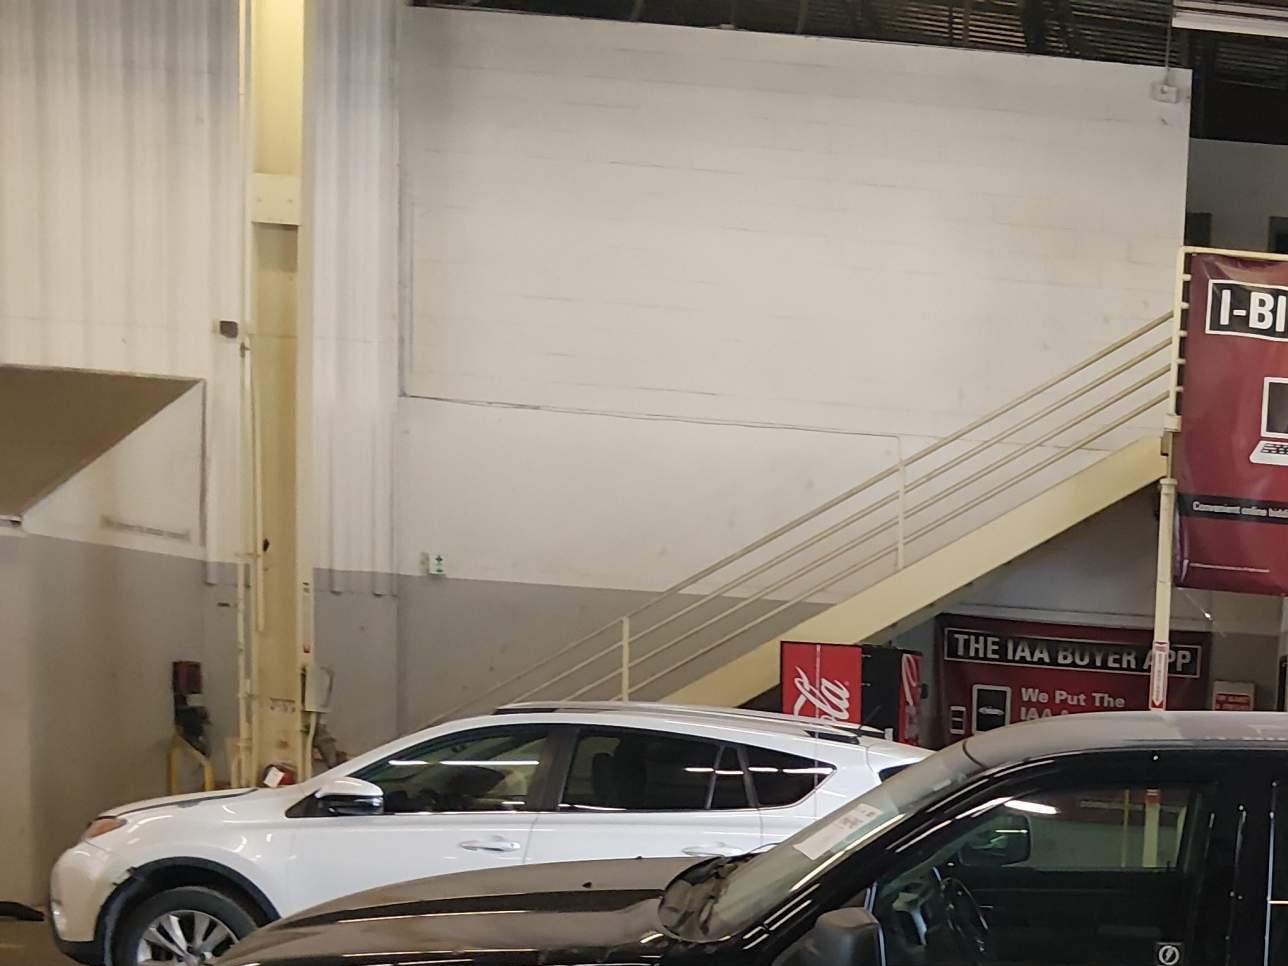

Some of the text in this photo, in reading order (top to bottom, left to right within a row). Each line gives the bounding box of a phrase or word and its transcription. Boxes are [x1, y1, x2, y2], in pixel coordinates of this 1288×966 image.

[954, 634, 1000, 659] THE
[1007, 638, 1050, 663] IAA
[1057, 645, 1136, 669] BUYER
[1021, 687, 1126, 708] We Put The
